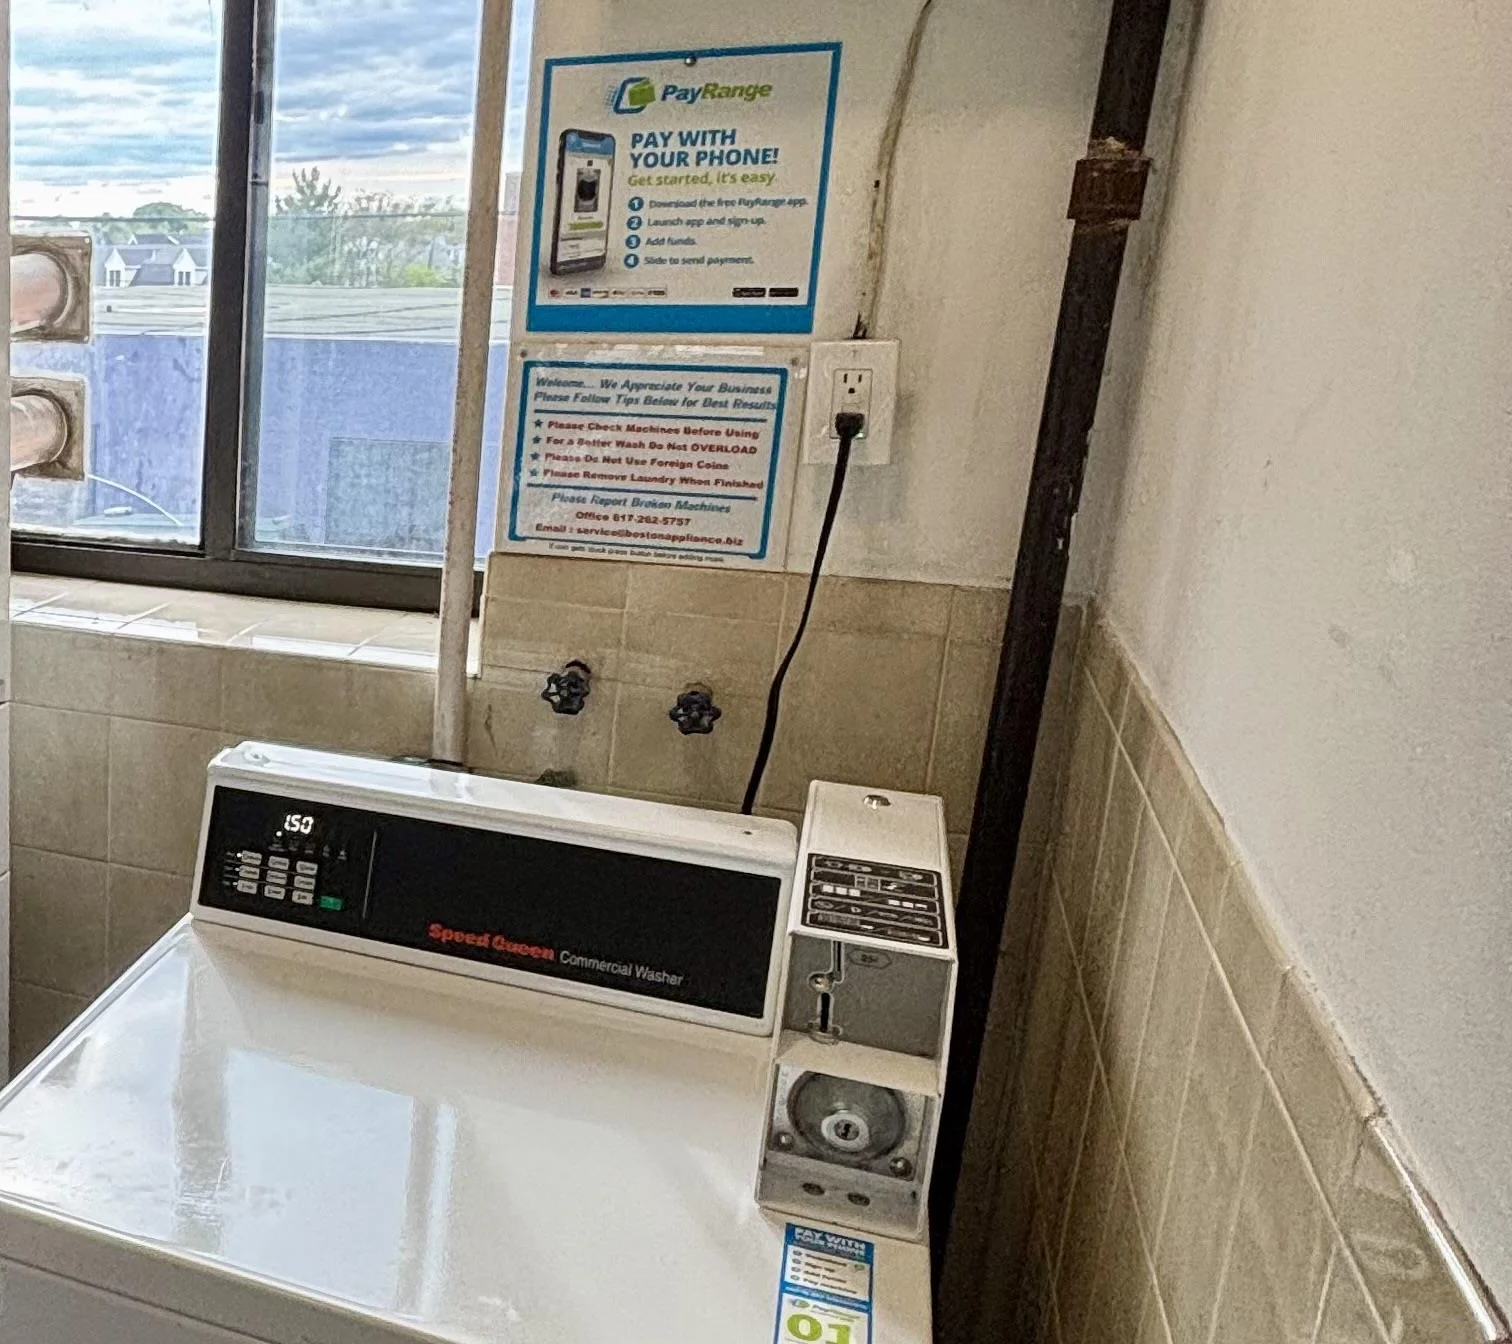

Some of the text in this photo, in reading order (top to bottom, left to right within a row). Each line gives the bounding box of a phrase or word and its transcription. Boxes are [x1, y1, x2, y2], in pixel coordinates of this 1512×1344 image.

[661, 82, 773, 104] PayRange
[631, 129, 736, 148] PAY WITH
[630, 148, 779, 169] YOUR PHONE!
[628, 175, 652, 186] Get
[655, 172, 712, 186] started,
[717, 171, 737, 183] it's
[649, 199, 697, 208] Download
[699, 198, 715, 208] the
[648, 218, 682, 227] Launch
[686, 218, 704, 228] app
[706, 217, 725, 225] and
[645, 237, 665, 246] Add
[644, 256, 667, 265] Slide
[669, 257, 679, 265] to
[682, 256, 704, 265] send
[600, 379, 617, 390] We
[621, 379, 682, 393] Appreciate
[688, 382, 714, 393] Your
[719, 383, 772, 395] Business
[534, 392, 777, 410] Please Follow Tips Below for Best Results
[548, 421, 759, 440] Please Check Machines Before Using
[546, 436, 563, 445] For
[577, 438, 611, 448] Better
[616, 439, 645, 449] Wash
[649, 441, 663, 450] Do
[667, 442, 687, 451] Not
[691, 443, 757, 455] OVERLOAD
[545, 452, 729, 470] Please Do Not Use Foreign Coins
[543, 468, 764, 490] Please Remove Laundry When Finished
[551, 492, 731, 514] Please Report Broken Machines
[575, 511, 609, 521] Office
[535, 523, 566, 534] Email
[429, 923, 683, 987] Speed Queen Commercial Washer
